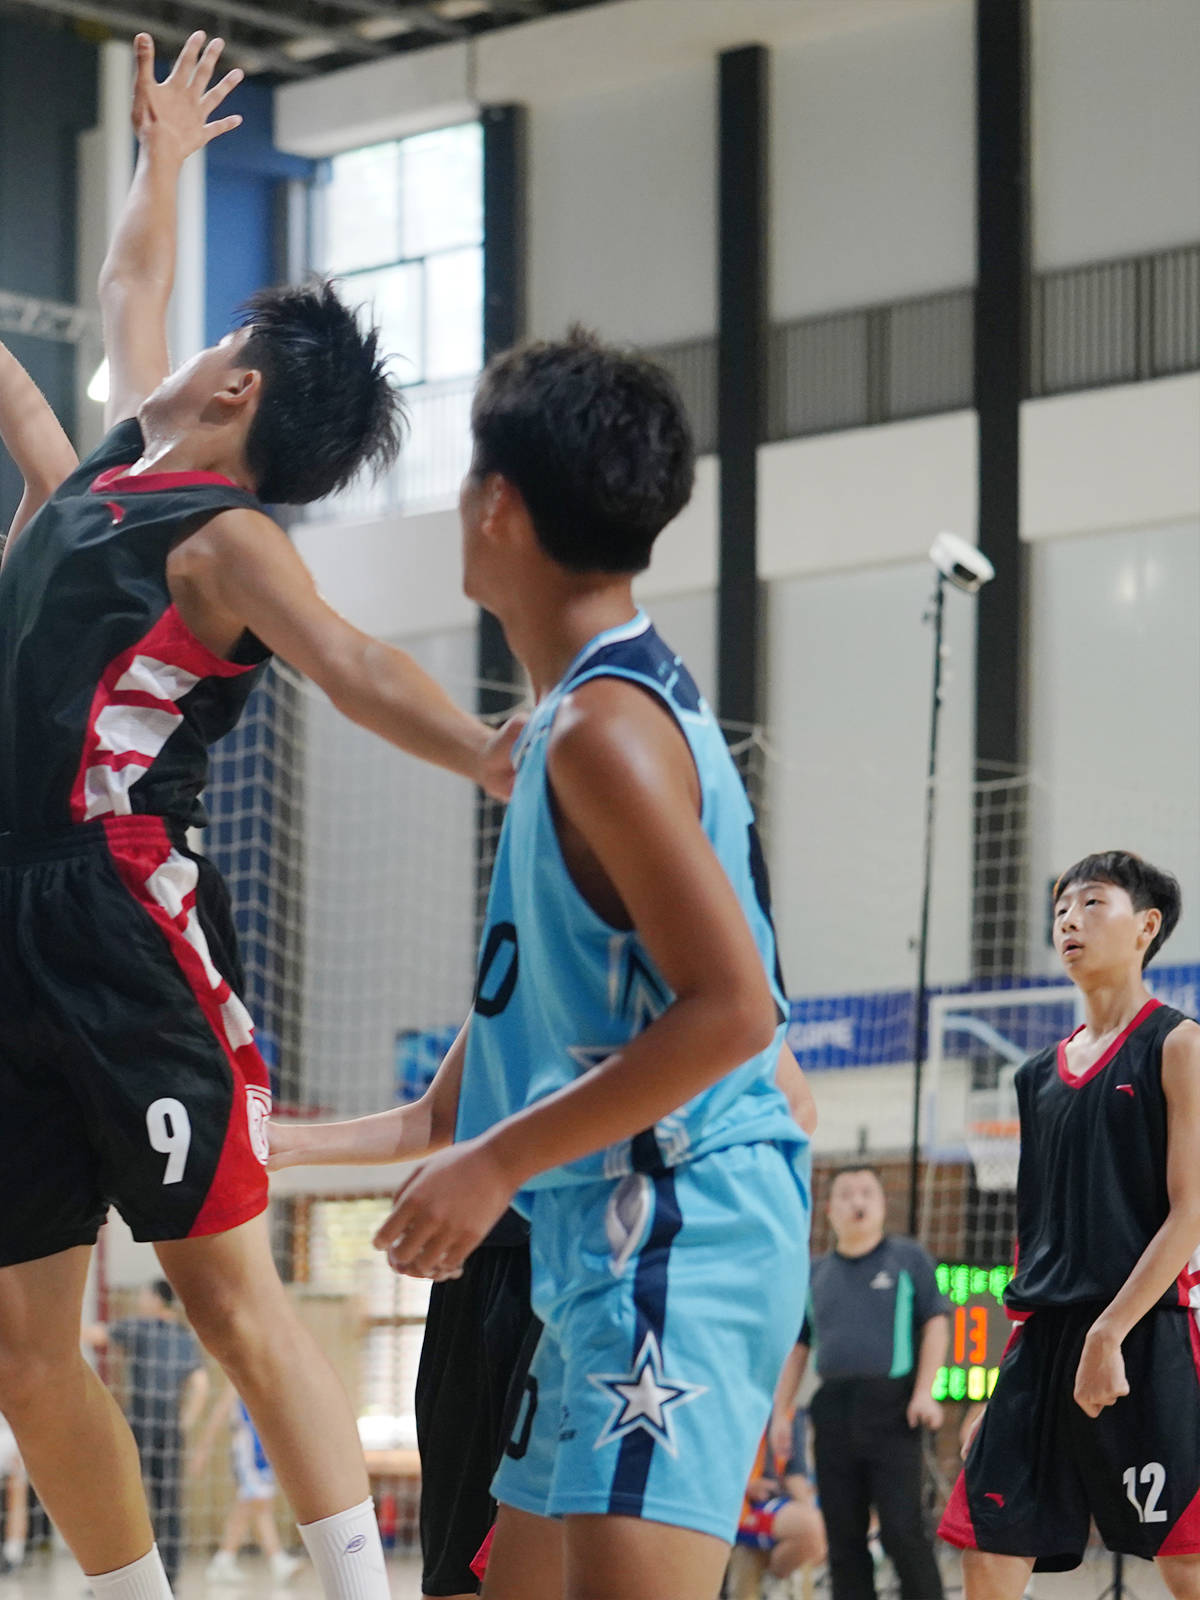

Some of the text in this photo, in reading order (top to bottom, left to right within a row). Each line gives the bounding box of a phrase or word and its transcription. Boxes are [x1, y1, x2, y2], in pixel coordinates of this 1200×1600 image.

[146, 1097, 192, 1185] 9
[954, 1306, 988, 1364] 13
[1123, 1462, 1167, 1523] 12
